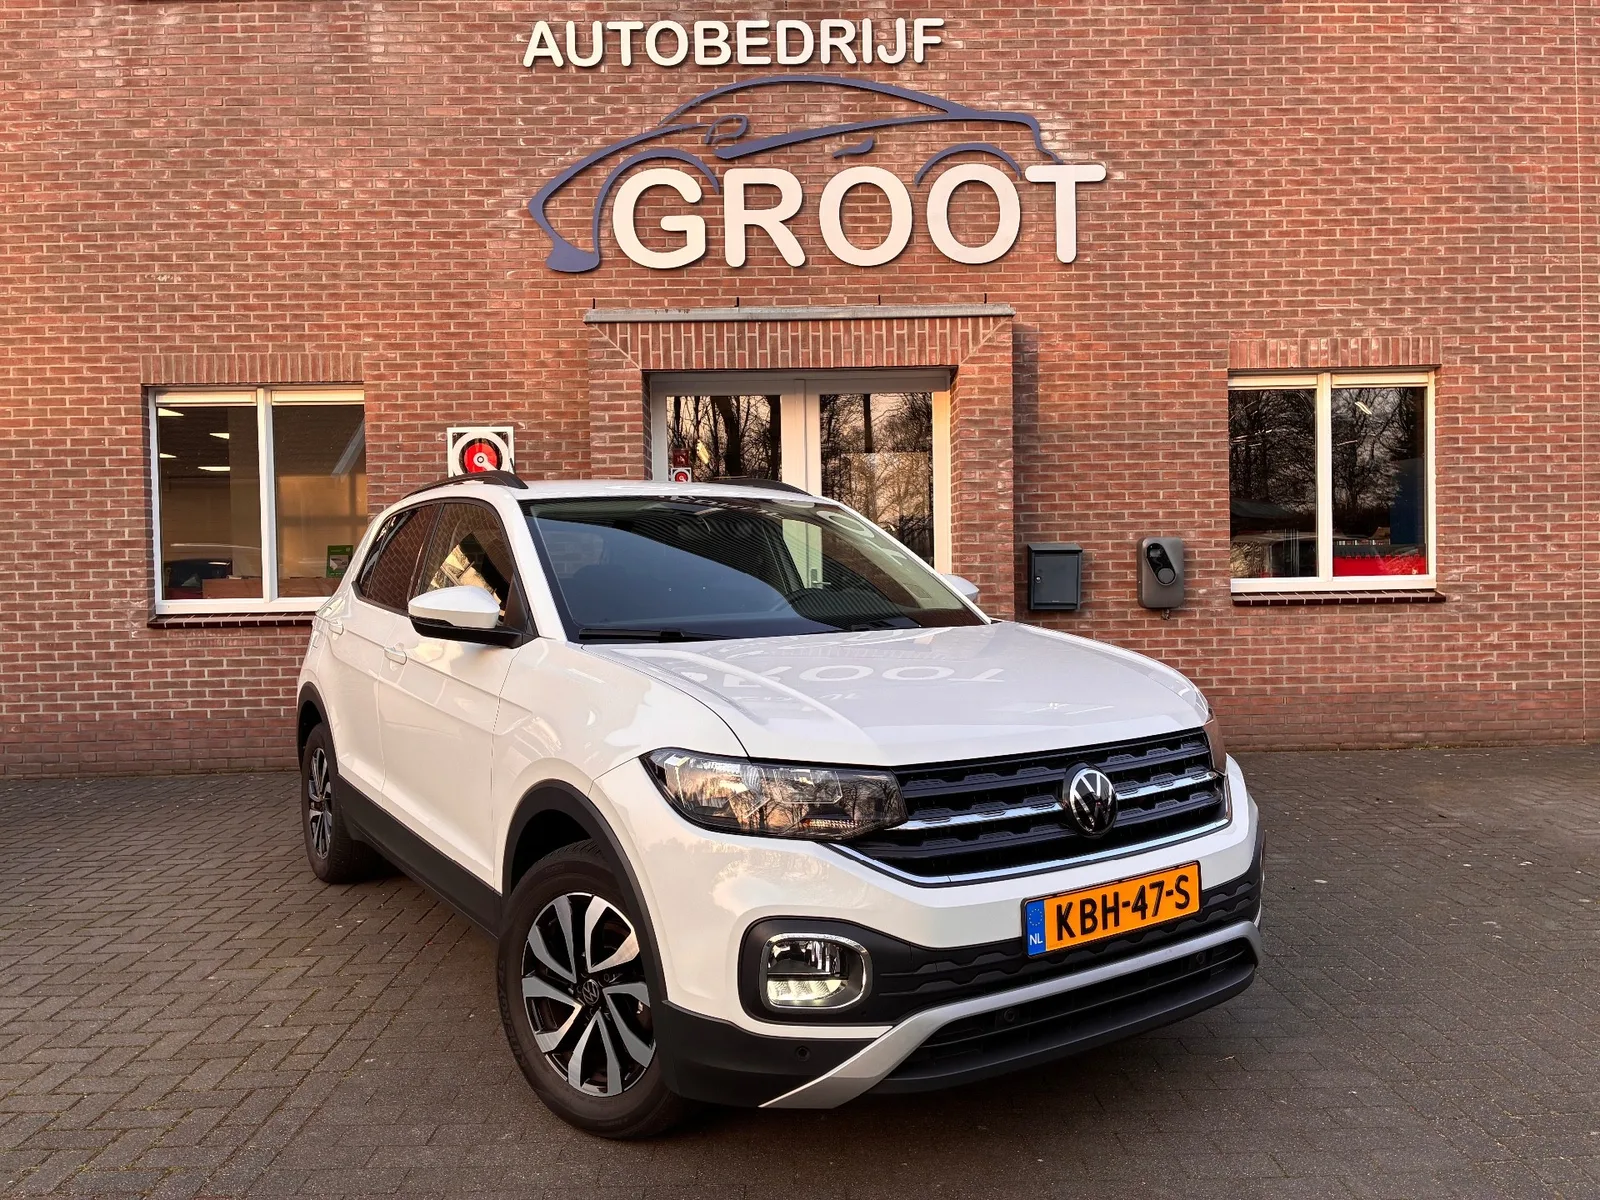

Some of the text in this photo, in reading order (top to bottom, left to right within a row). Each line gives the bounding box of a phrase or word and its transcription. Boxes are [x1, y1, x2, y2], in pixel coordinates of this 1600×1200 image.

[523, 18, 945, 67] AUTOBEDRIJF
[612, 163, 1106, 269] GROOT
[1056, 874, 1190, 942] KBH-47-S
[1029, 933, 1044, 946] NL
